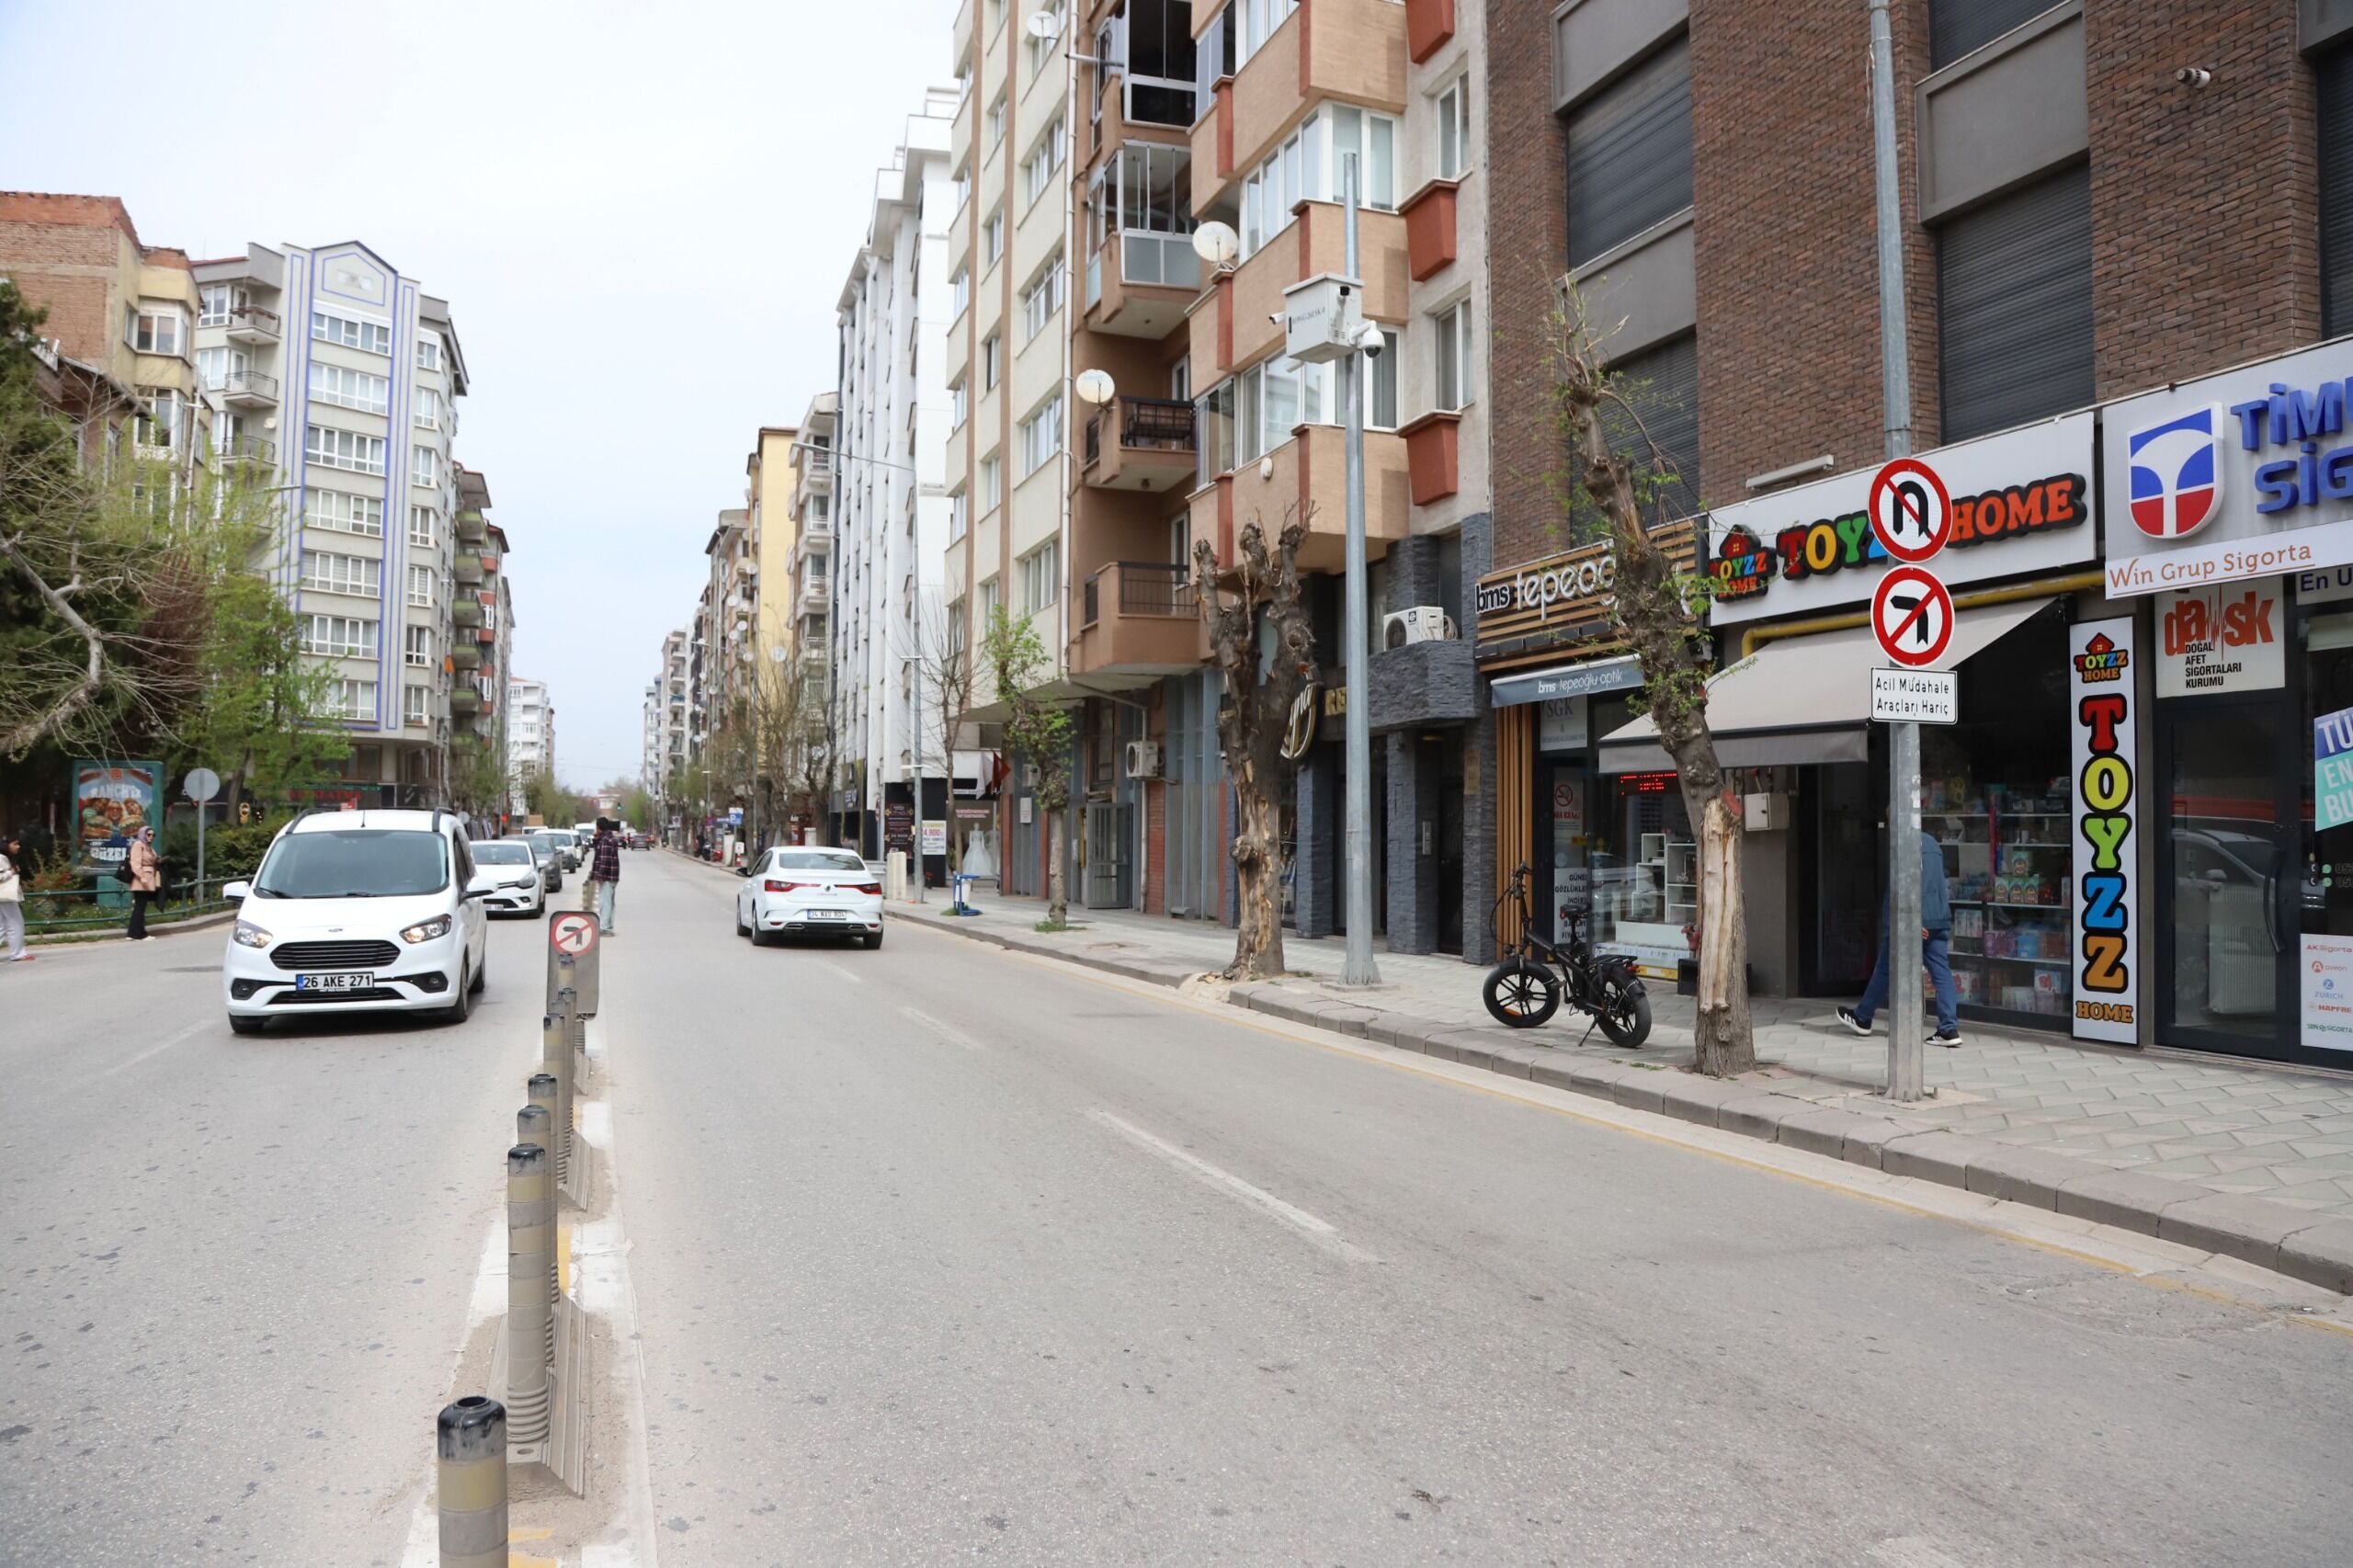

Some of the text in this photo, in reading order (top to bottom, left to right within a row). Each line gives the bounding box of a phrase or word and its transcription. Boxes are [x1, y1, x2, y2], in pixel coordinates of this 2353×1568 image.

[2231, 377, 2353, 451] TİM
[1949, 479, 2075, 543] HOME
[2109, 544, 2312, 588] Win Grup Sigorta
[2301, 572, 2328, 593] En
[1475, 583, 1510, 614] bms
[2165, 591, 2275, 656] dask
[2185, 641, 2213, 653] DOĞAL
[2075, 651, 2128, 671] TOYZZ
[2185, 654, 2206, 665] AFET
[1538, 668, 1622, 694] bms tepeoğlu optik
[1876, 676, 1895, 691] Acil
[2084, 667, 2120, 682] HOME
[2186, 676, 2224, 688] KURUMU
[1877, 698, 1949, 716] Araçları Hariç
[2081, 696, 2131, 990] TOYZZ
[303, 975, 370, 988] 26 AKE 271
[2314, 991, 2344, 1000] ZURICH
[2075, 1001, 2133, 1023] HOME
[2318, 1004, 2353, 1013] MAPFRE
